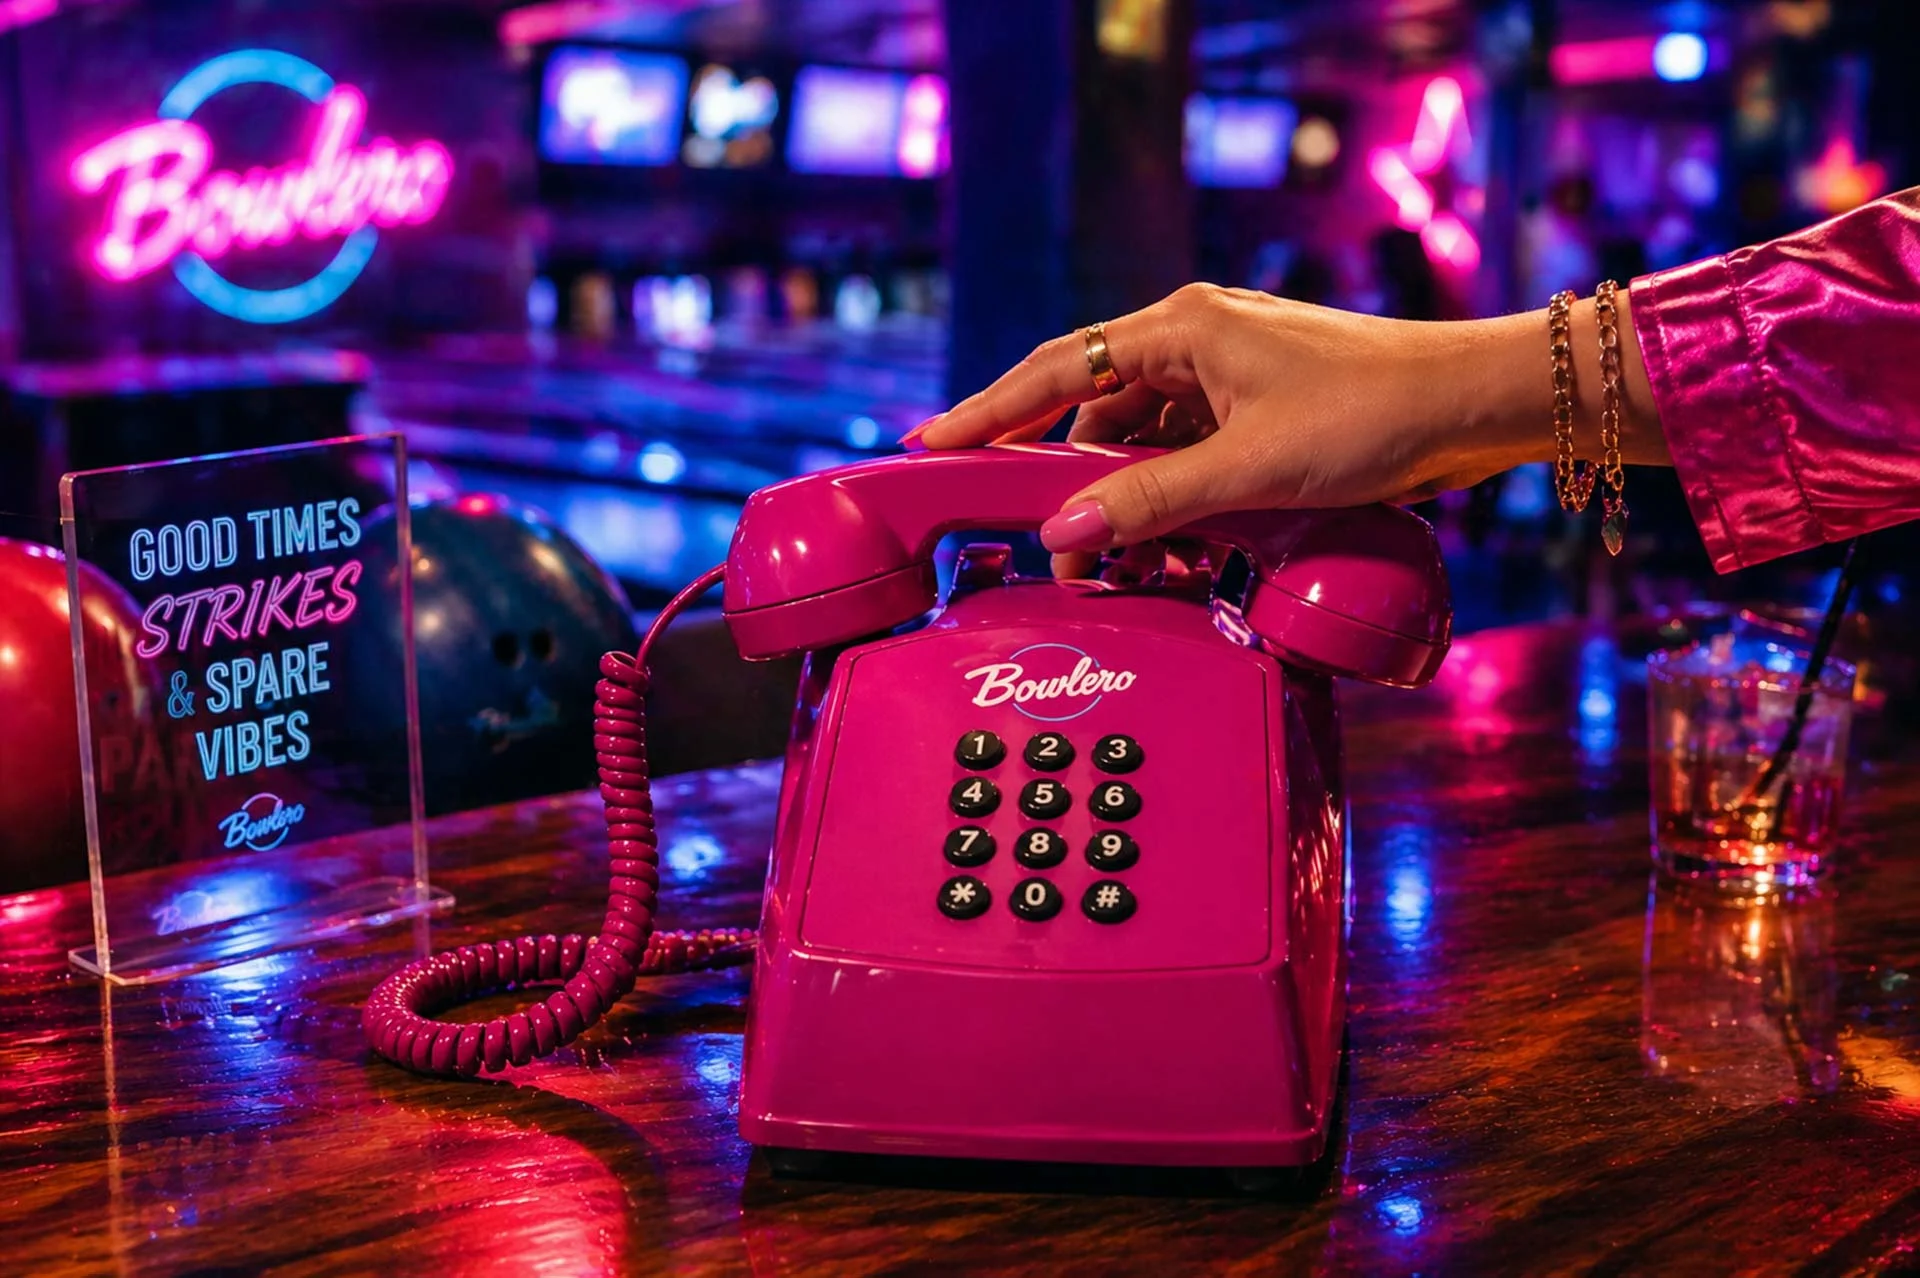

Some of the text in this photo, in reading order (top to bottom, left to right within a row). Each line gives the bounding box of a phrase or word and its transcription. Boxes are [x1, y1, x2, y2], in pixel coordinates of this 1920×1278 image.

[130, 497, 361, 581] GOOD TIMES
[136, 560, 363, 659] STRIKES
[167, 641, 331, 719] & SPARE
[964, 656, 1137, 708] Bowlero
[195, 710, 311, 781] VIBES
[973, 734, 1128, 759] 1 2 3
[962, 781, 1125, 807] 4 5 6
[959, 830, 1123, 856] 7 8 9
[1025, 883, 1047, 906] 0
[1096, 885, 1121, 907] #
